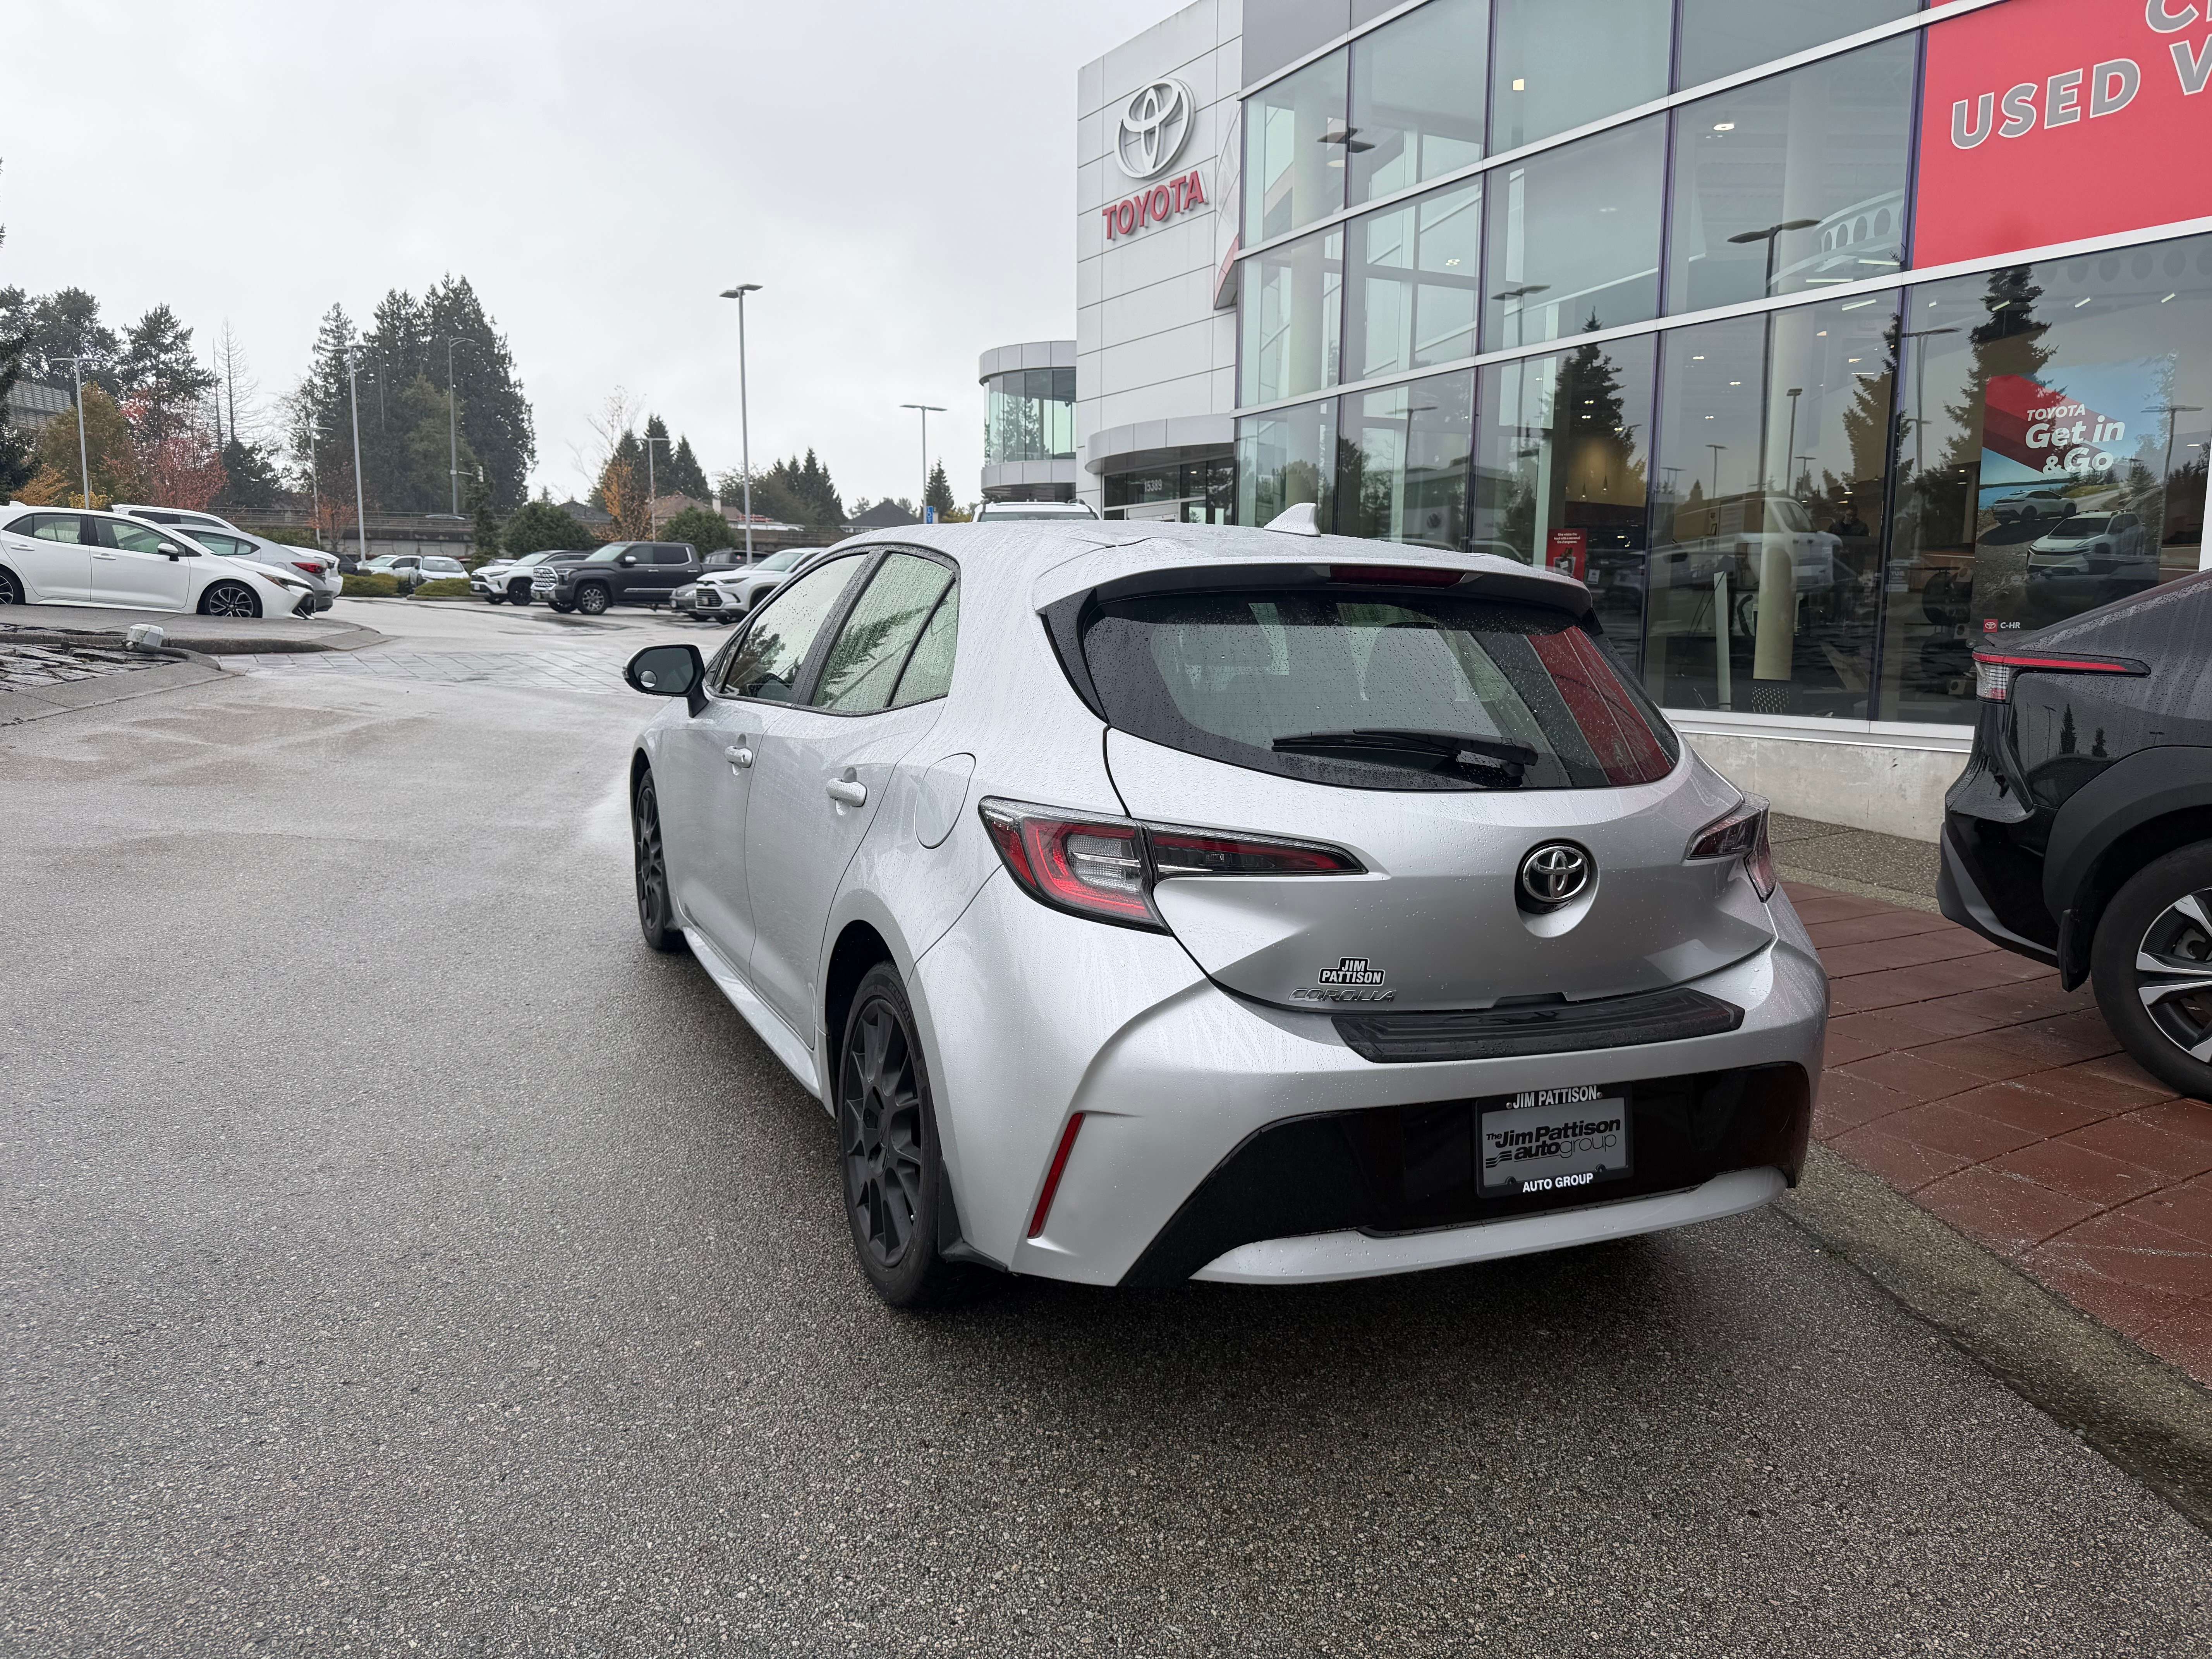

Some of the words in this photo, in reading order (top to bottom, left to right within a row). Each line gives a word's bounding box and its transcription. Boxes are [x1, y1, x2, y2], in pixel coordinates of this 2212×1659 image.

[2145, 0, 2212, 33] C
[1951, 58, 2141, 150] USED
[1102, 170, 1207, 240] TOYOTA
[2027, 404, 2085, 421] TOYOTA
[2026, 421, 2087, 449] Get
[2092, 415, 2125, 443] in
[1144, 479, 1162, 492] 15389
[1322, 970, 1382, 983] PATTISON
[1342, 960, 1365, 972] JIM
[888, 982, 912, 1028] GENERAL
[1288, 988, 1397, 1003] COROLLA
[1513, 1092, 1535, 1109] JIM
[1538, 1085, 1597, 1106] PATTISON
[1486, 1133, 1503, 1141] The
[1495, 1129, 1533, 1148] Jim
[1535, 1118, 1621, 1143] Pattison
[1522, 1178, 1553, 1194] AUTO
[1555, 1172, 1594, 1188] GROUP
